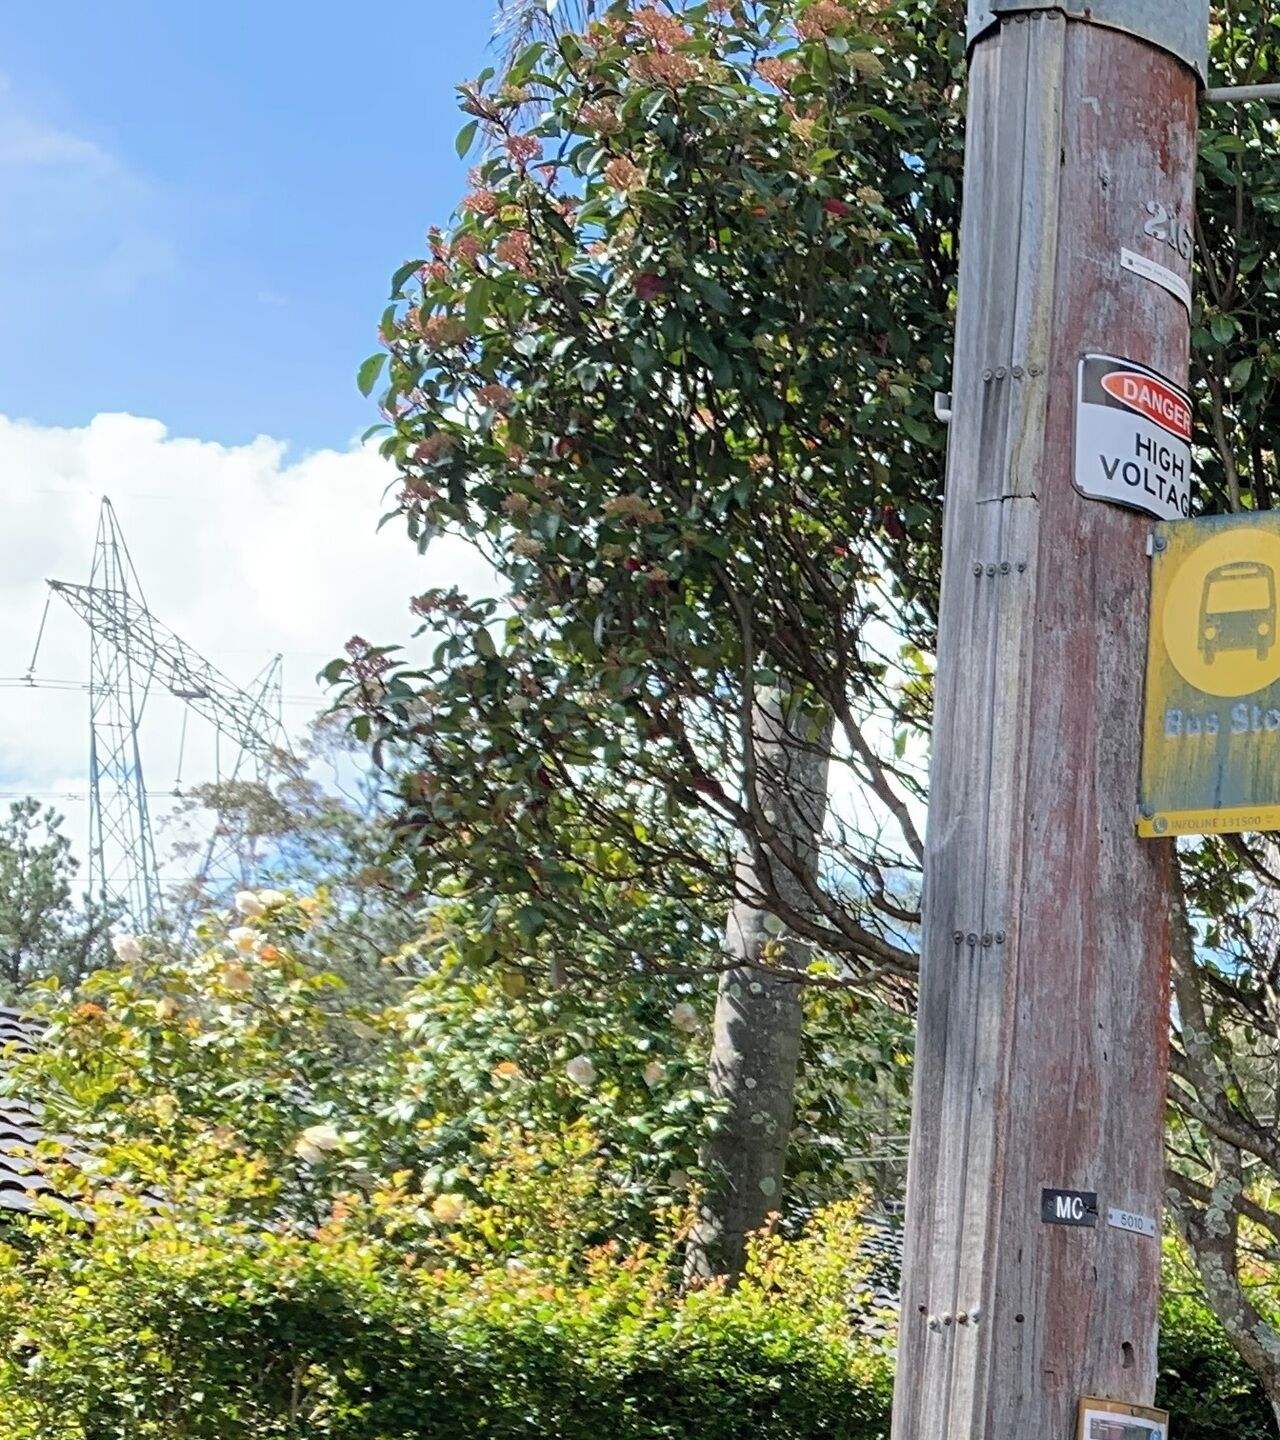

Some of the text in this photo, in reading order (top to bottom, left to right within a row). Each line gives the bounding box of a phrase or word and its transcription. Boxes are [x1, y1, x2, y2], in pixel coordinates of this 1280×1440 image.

[1123, 378, 1191, 434] DANGER
[1135, 432, 1184, 483] HIGH
[1099, 454, 1189, 517] VOLTAG
[1165, 708, 1219, 737] Bus
[1171, 816, 1218, 830] INFOLINE
[1222, 815, 1261, 828] 131500
[1056, 1196, 1083, 1220] MC
[1120, 1213, 1144, 1231] 5010
